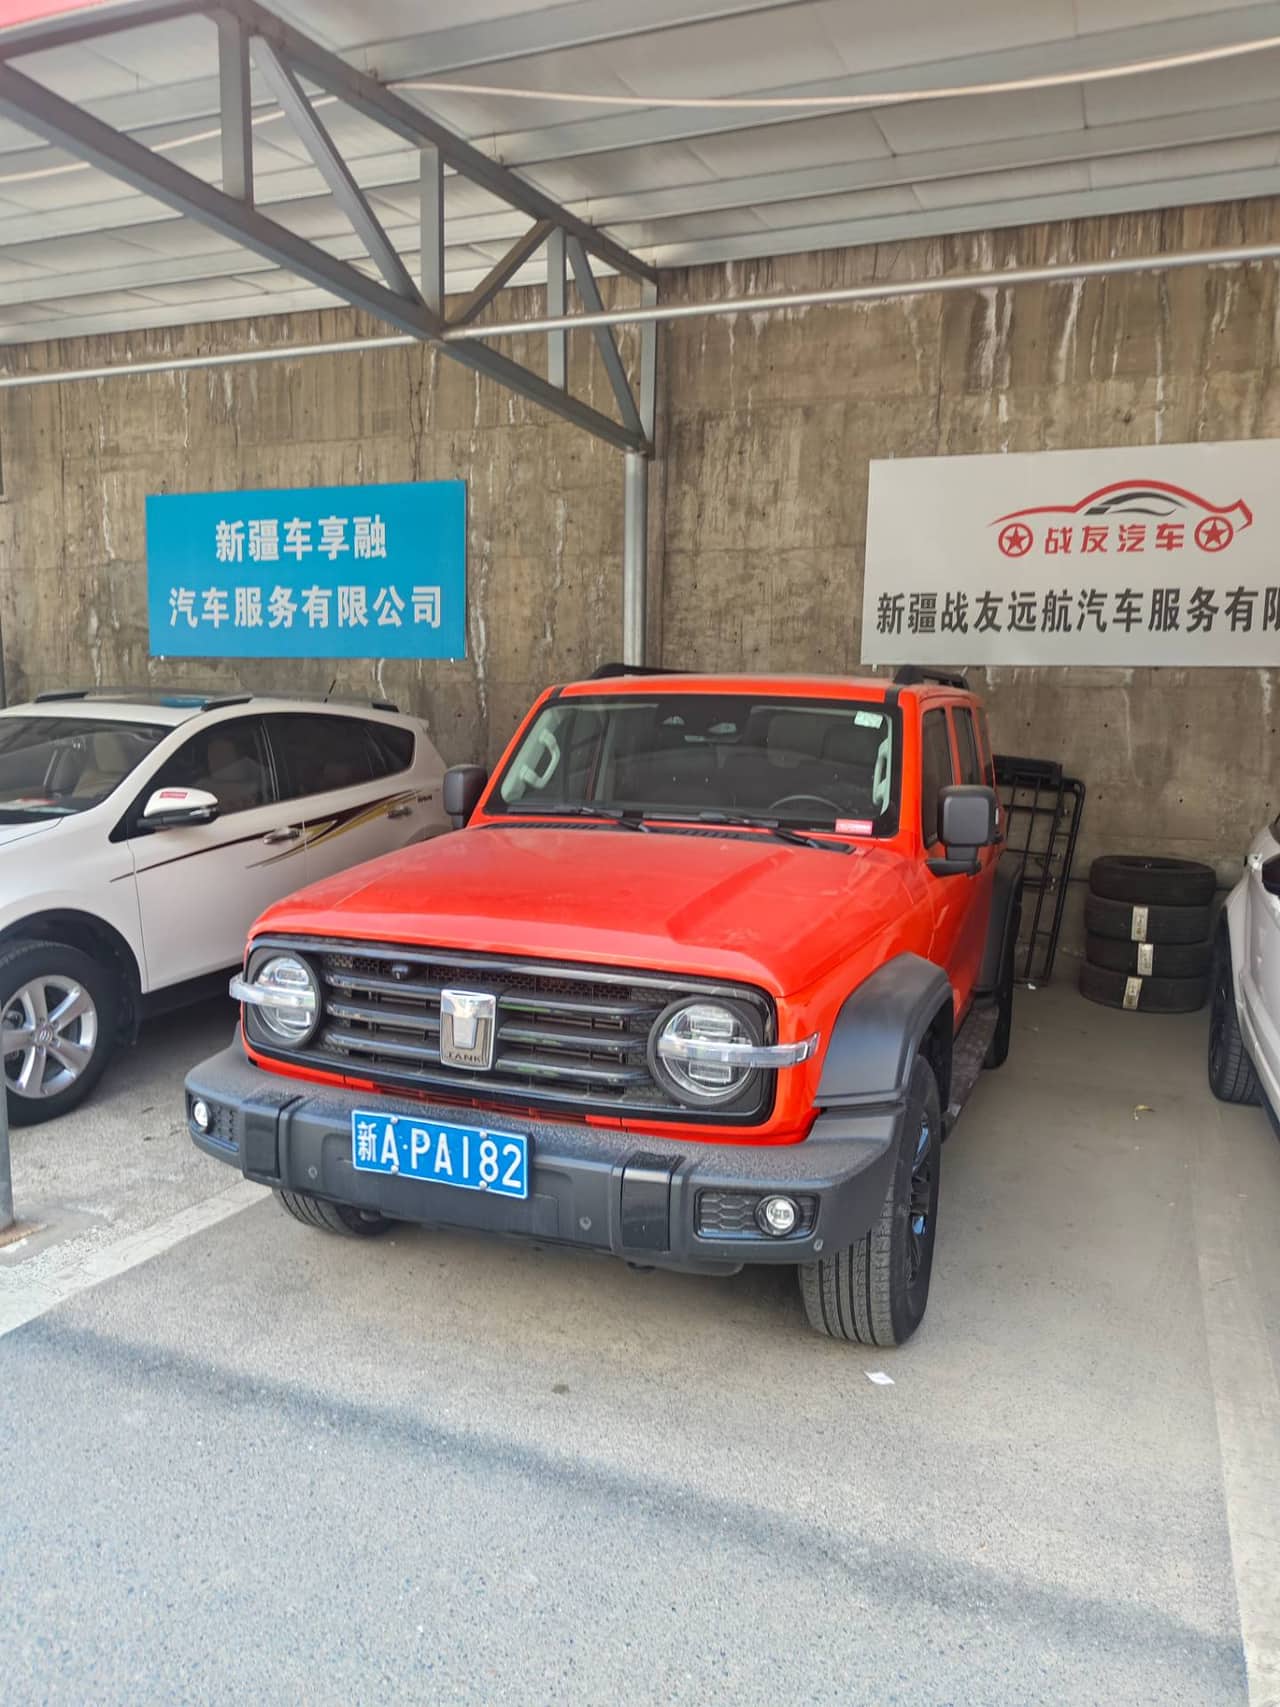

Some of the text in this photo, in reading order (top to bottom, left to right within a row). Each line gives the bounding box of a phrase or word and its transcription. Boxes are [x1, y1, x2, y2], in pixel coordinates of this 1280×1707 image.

[215, 514, 388, 562] 新疆车享融
[1044, 523, 1185, 555] 战友汽车
[168, 584, 442, 629] 汽车服务有限公司
[447, 1052, 481, 1063] TANK
